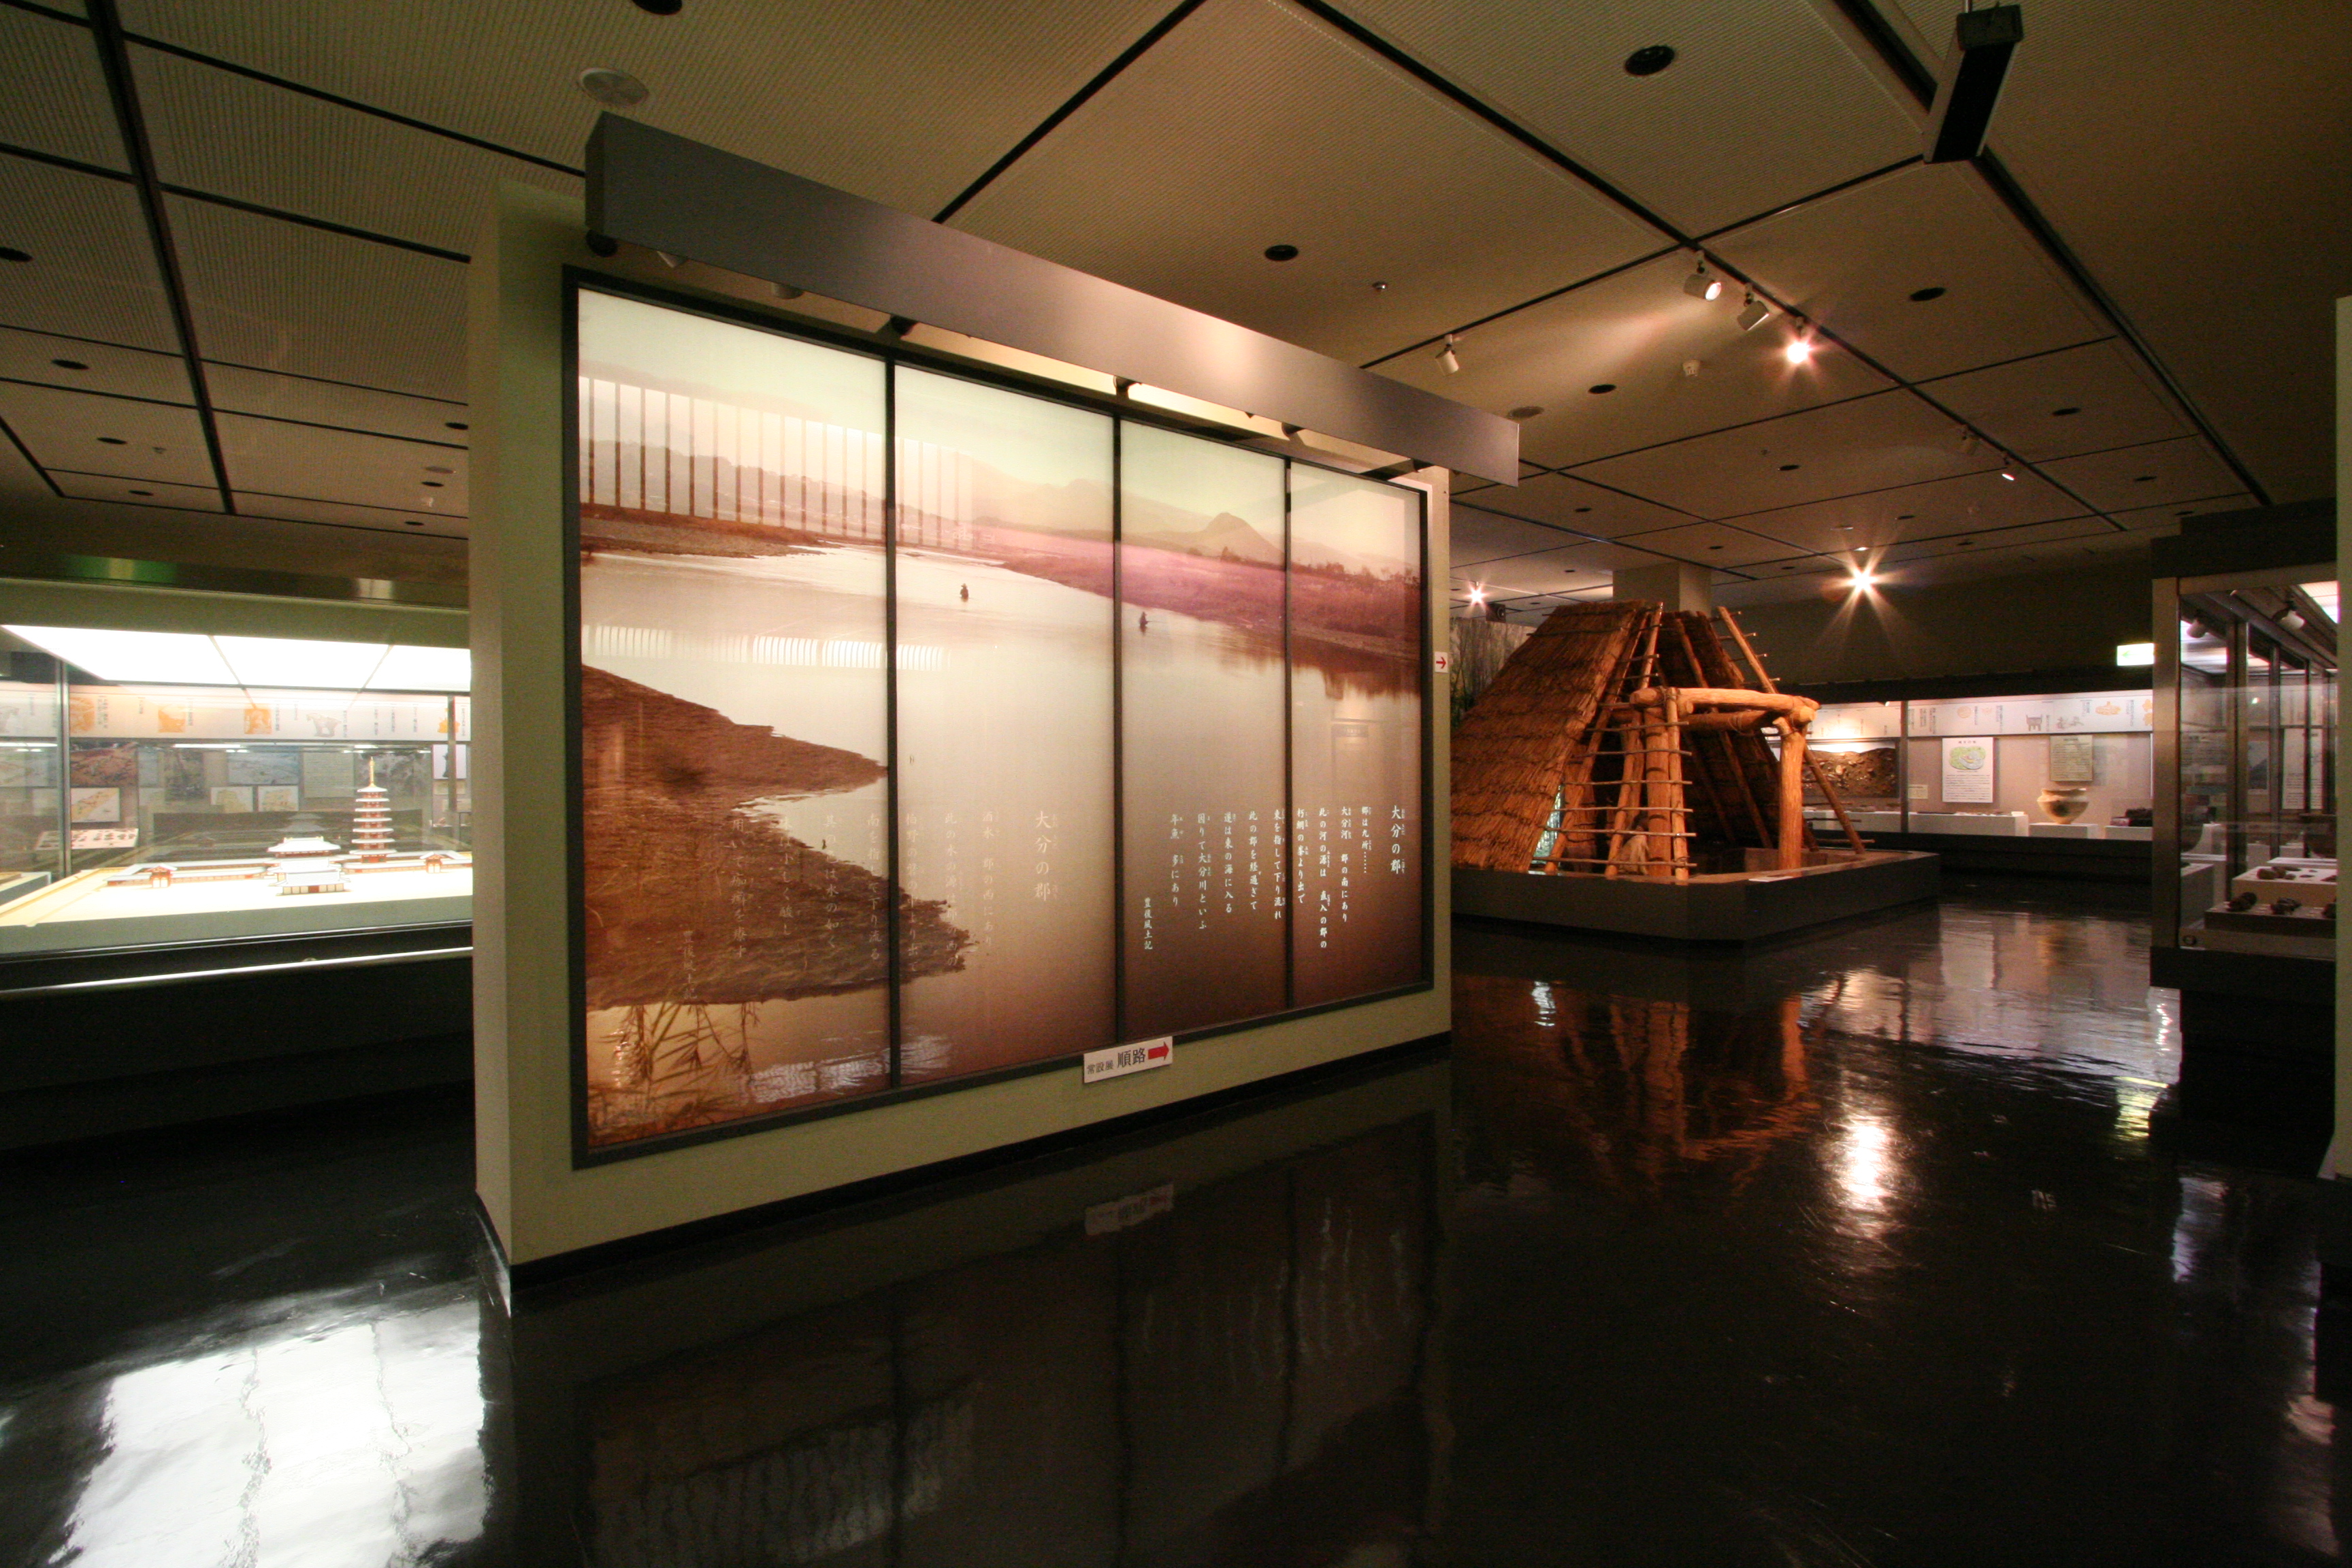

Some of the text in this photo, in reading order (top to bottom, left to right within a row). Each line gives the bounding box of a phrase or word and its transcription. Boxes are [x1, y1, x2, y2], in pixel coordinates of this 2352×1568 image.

[1034, 810, 1052, 902] 大分の郡
[1170, 813, 1180, 907] 年魚 多にあり
[1197, 813, 1207, 930] 因りて大分川といふ
[1341, 806, 1349, 923] 大分河 郡の南にあり
[1390, 805, 1402, 875] 大分の郡
[1143, 896, 1153, 950] 豊後風土記
[1319, 890, 1328, 949] 直入の郡の
[1086, 1047, 1146, 1075] 常設展 順路
